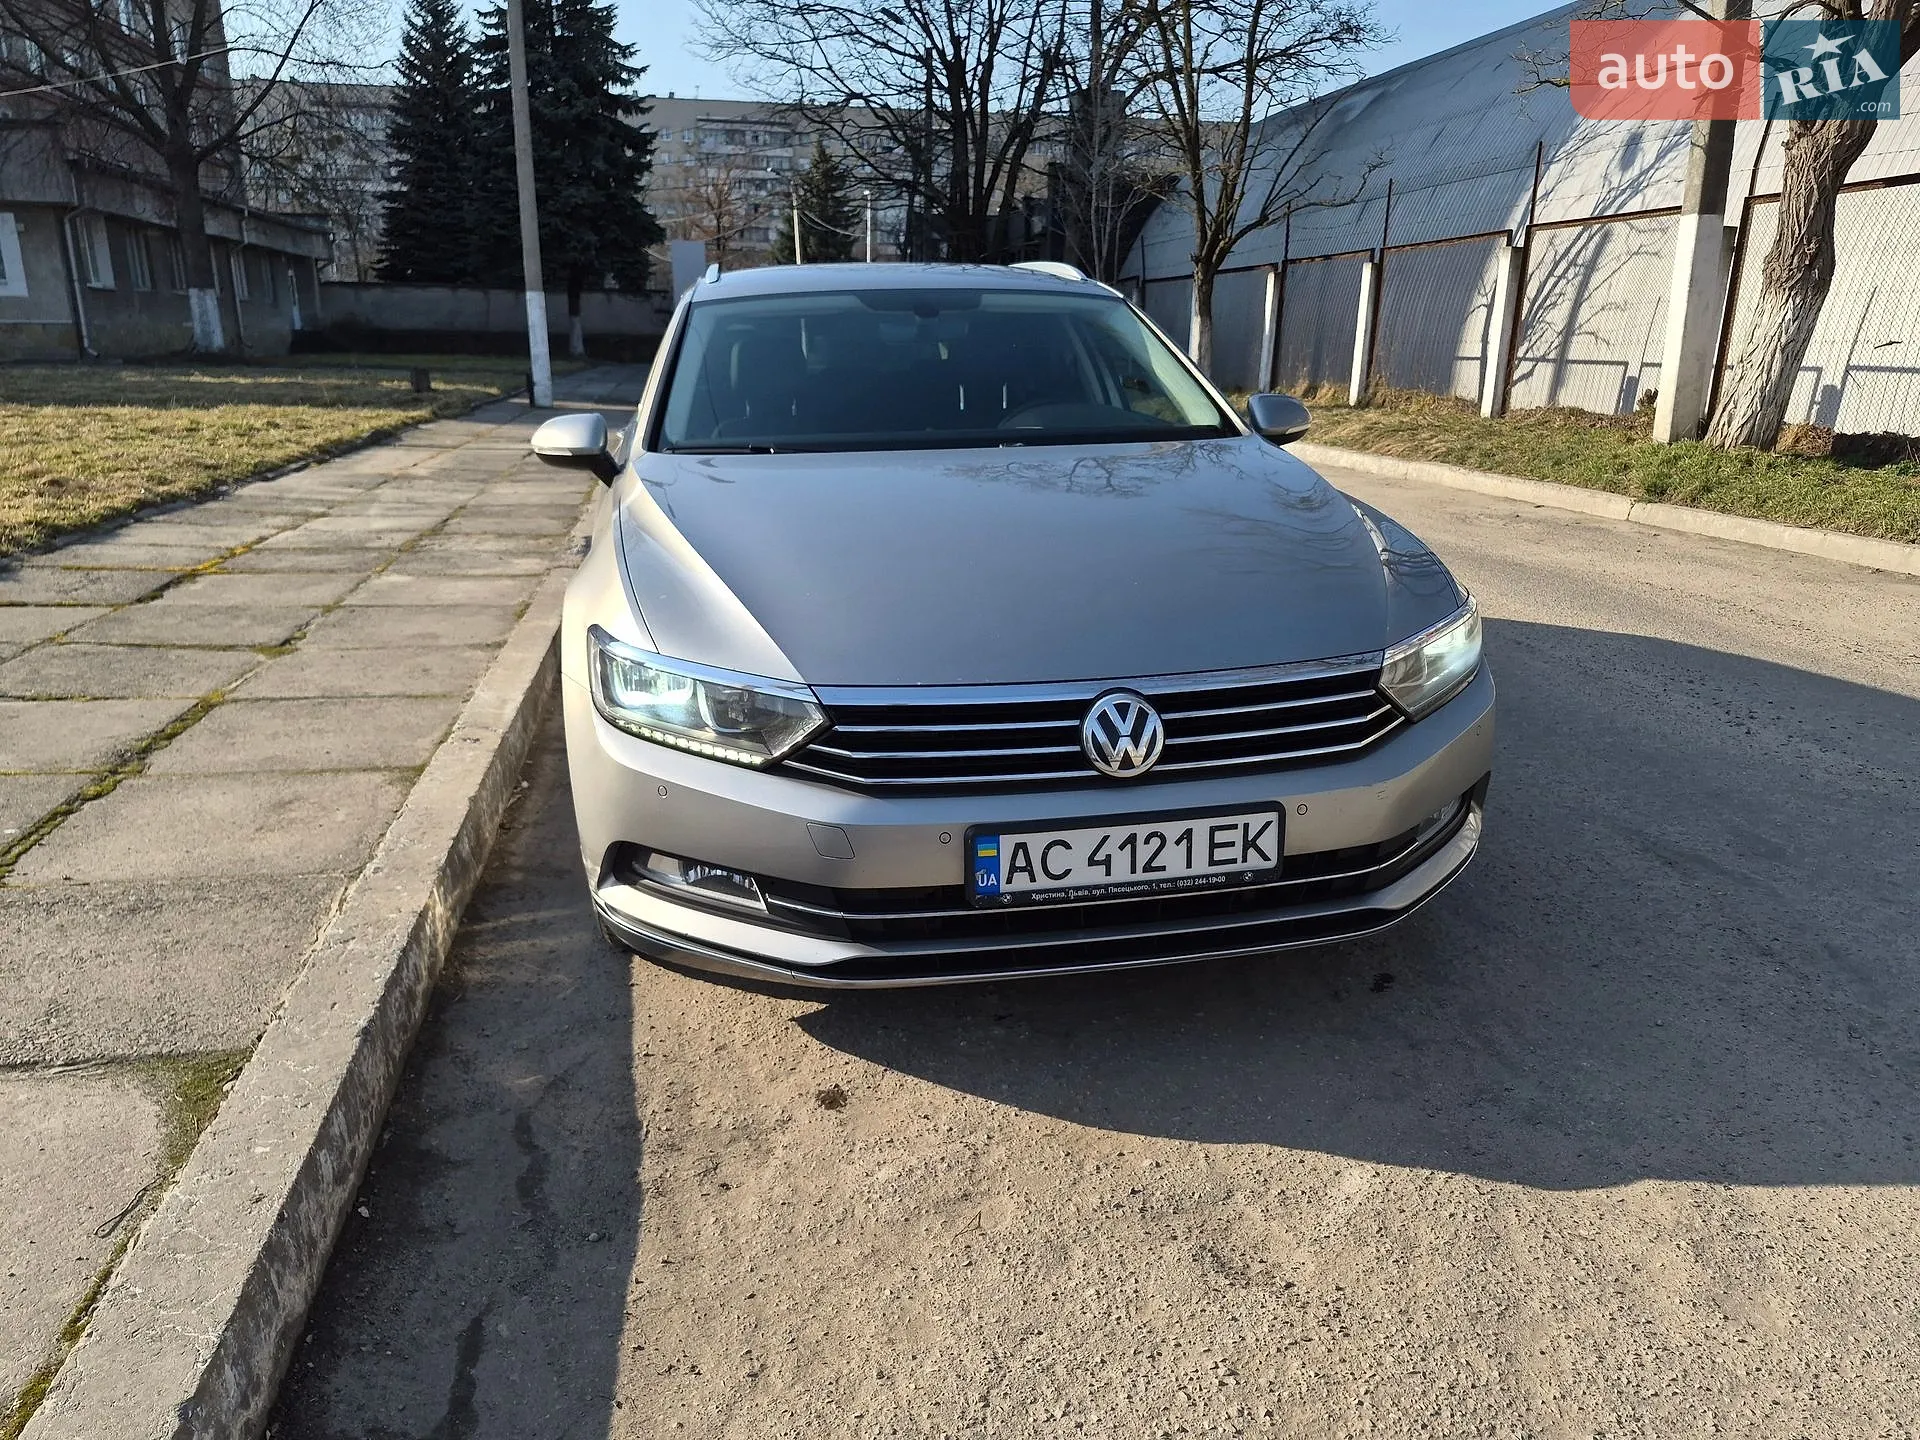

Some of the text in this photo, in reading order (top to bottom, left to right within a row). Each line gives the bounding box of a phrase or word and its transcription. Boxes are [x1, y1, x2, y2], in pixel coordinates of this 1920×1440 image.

[1005, 819, 1275, 885] AC 4121 EK
[978, 873, 998, 887] UA
[1177, 879, 1194, 888] (032)
